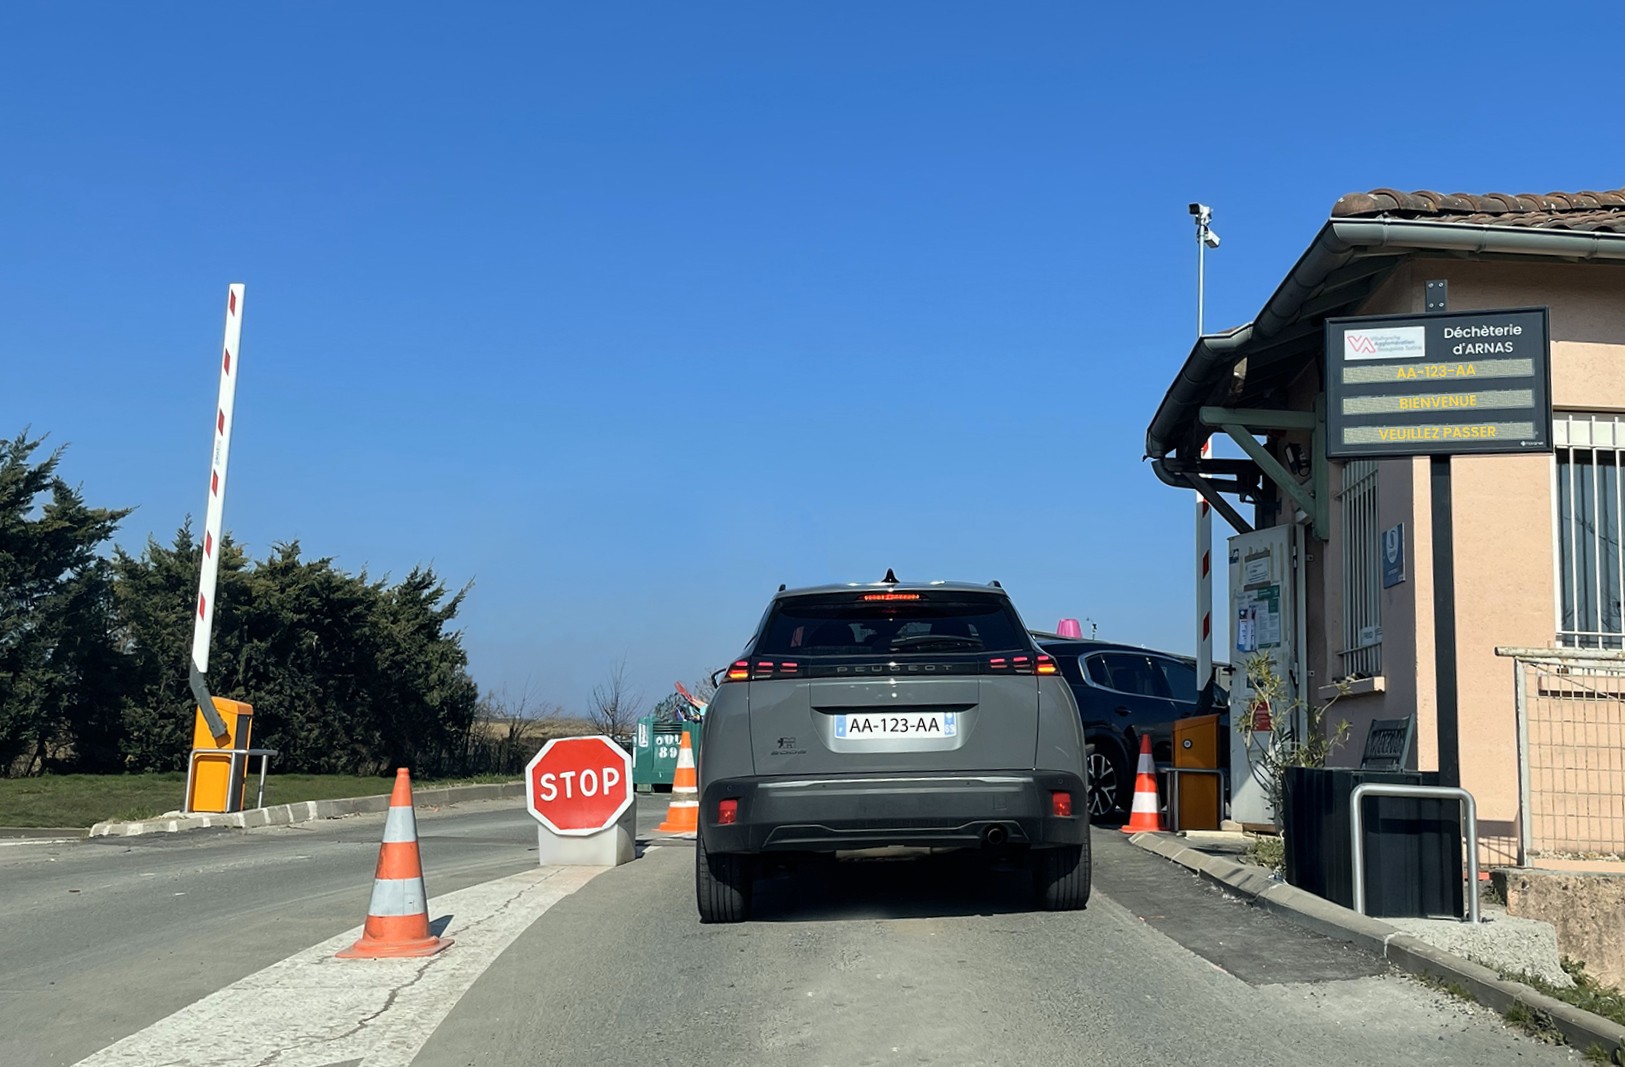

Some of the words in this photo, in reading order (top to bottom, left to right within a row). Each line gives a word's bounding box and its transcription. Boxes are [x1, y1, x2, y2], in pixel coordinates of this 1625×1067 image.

[1444, 324, 1522, 339] Déchèterie
[1453, 341, 1514, 355] d'ARNAS
[1396, 364, 1476, 379] AA-123-AA
[1399, 395, 1477, 409] BIENVENUE
[1379, 427, 1439, 441] VEUILLEZ
[1443, 426, 1496, 439] PASSER
[837, 665, 952, 673] PEUGEOT
[849, 717, 940, 733] AA-123-AA
[540, 767, 620, 802] STOP
